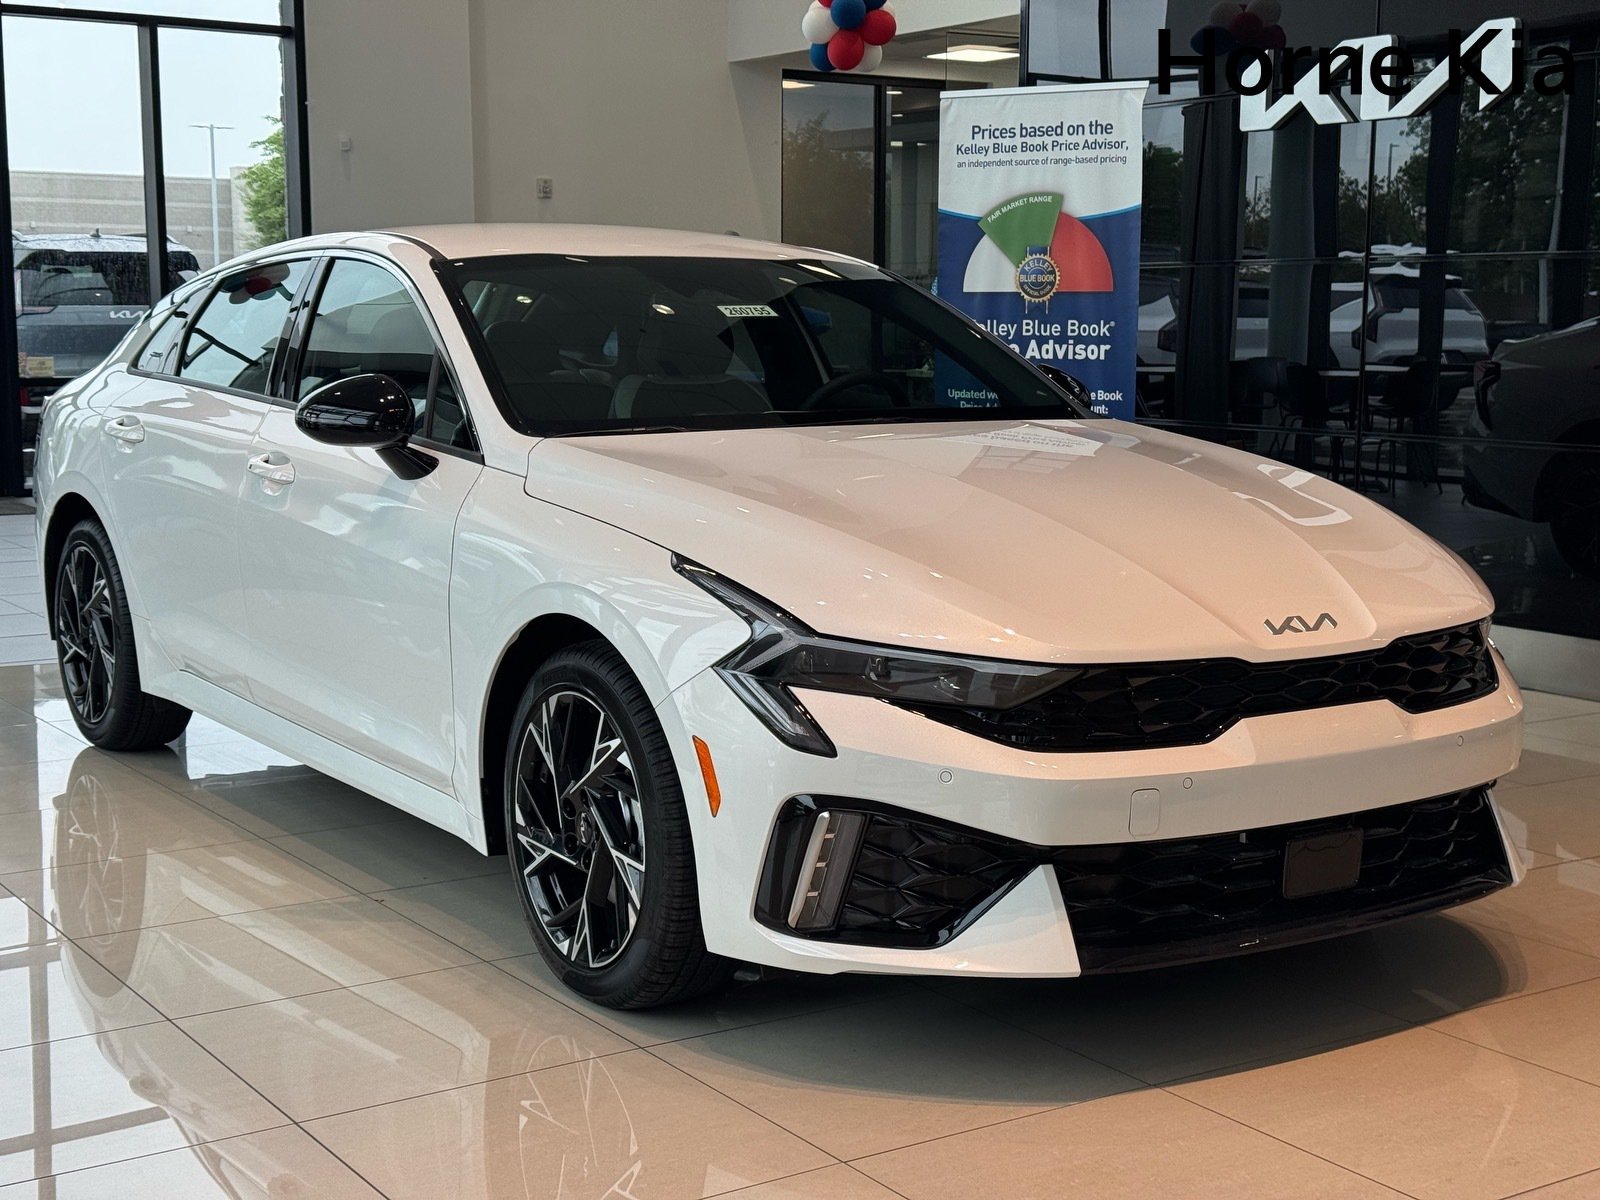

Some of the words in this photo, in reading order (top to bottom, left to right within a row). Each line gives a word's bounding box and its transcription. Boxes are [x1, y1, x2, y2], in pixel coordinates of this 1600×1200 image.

[971, 124, 1017, 140] Prices
[1019, 121, 1064, 138] based
[1067, 124, 1086, 136] on
[1088, 119, 1114, 135] the
[956, 143, 990, 157] Kelley
[992, 142, 1018, 154] Blue
[1020, 140, 1049, 153] Book
[1051, 139, 1080, 151] Price
[1081, 137, 1129, 151] Advisor,
[967, 158, 1013, 169] independent
[1014, 157, 1040, 167] source
[1041, 156, 1049, 165] of
[1049, 154, 1099, 167] range-based
[1099, 154, 1127, 166] pricing
[986, 210, 1002, 224] FAIR
[1001, 198, 1028, 214] MARKET
[1028, 195, 1053, 205] RANGE
[1023, 259, 1054, 272] KELLEY
[1019, 274, 1037, 283] BLUE
[1037, 274, 1056, 283] BOOK
[724, 306, 772, 317] 260755
[979, 319, 1018, 340] lley
[1022, 319, 1061, 336] Blue
[1025, 339, 1112, 361] Advisor
[947, 388, 986, 400] Updated
[1097, 390, 1123, 401] Book
